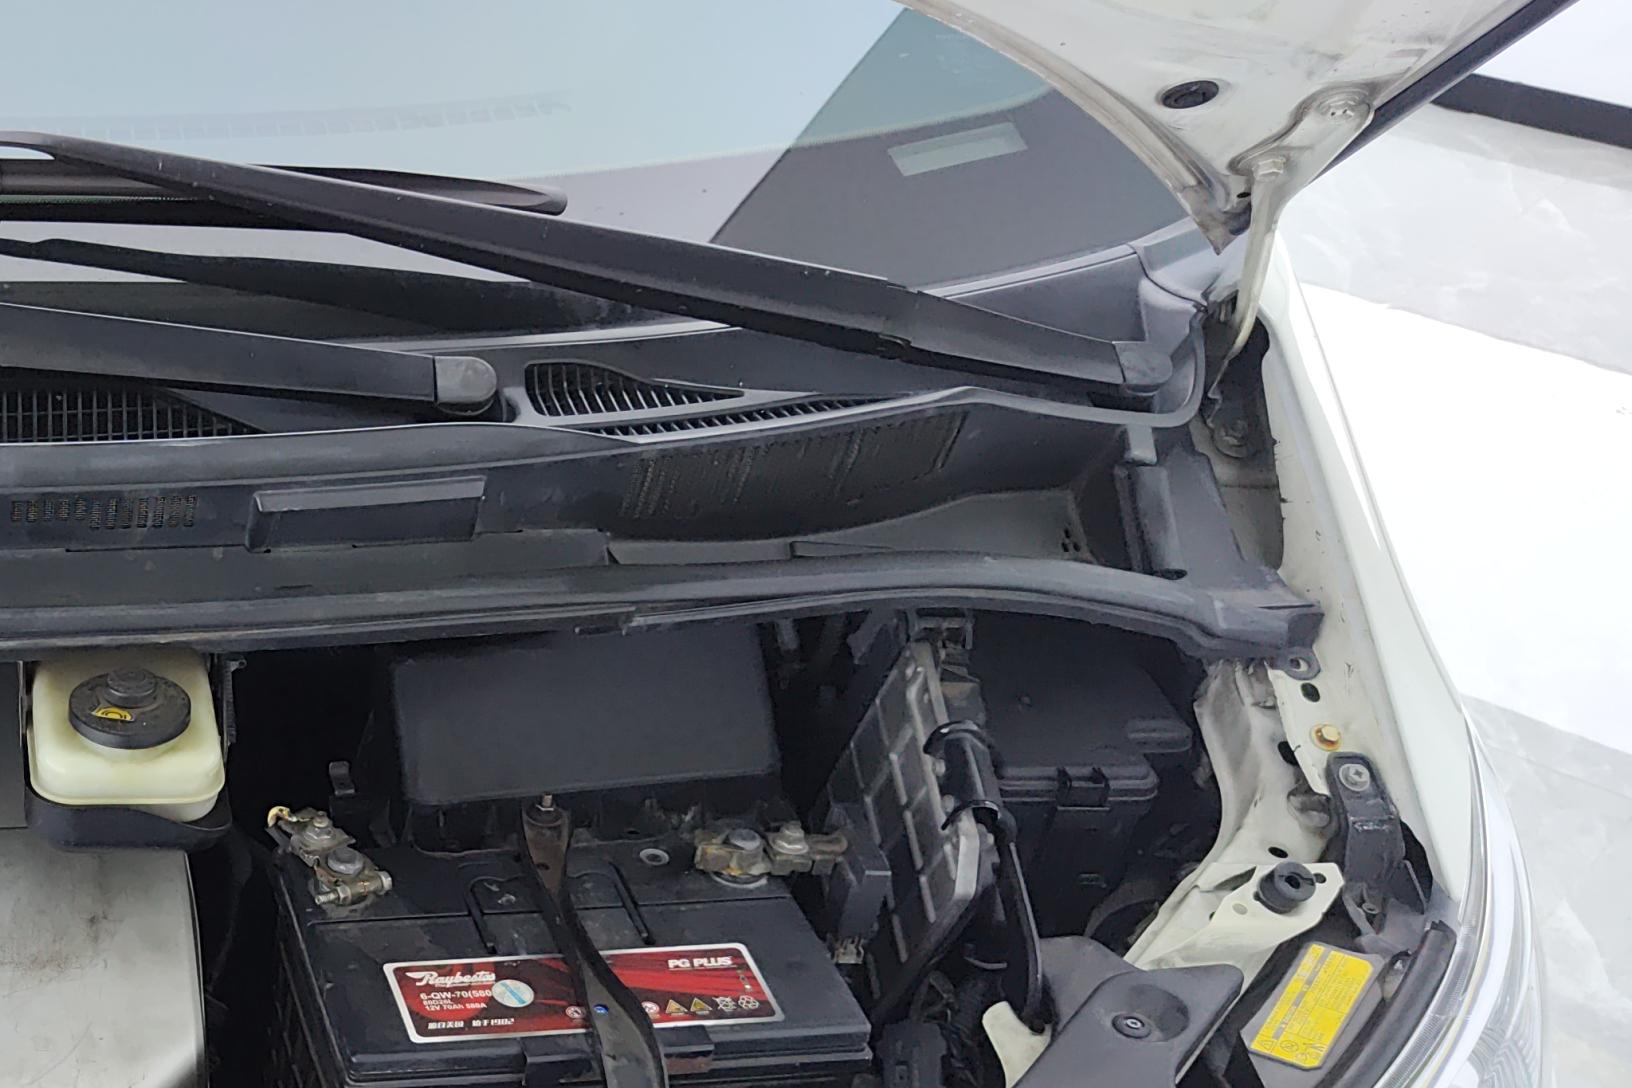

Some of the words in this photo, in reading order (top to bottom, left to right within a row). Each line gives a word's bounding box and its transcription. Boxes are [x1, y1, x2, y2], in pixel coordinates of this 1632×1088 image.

[668, 959, 690, 969] PG
[693, 956, 733, 967] PLUS
[420, 989, 492, 1000] 6-QW-70(580
